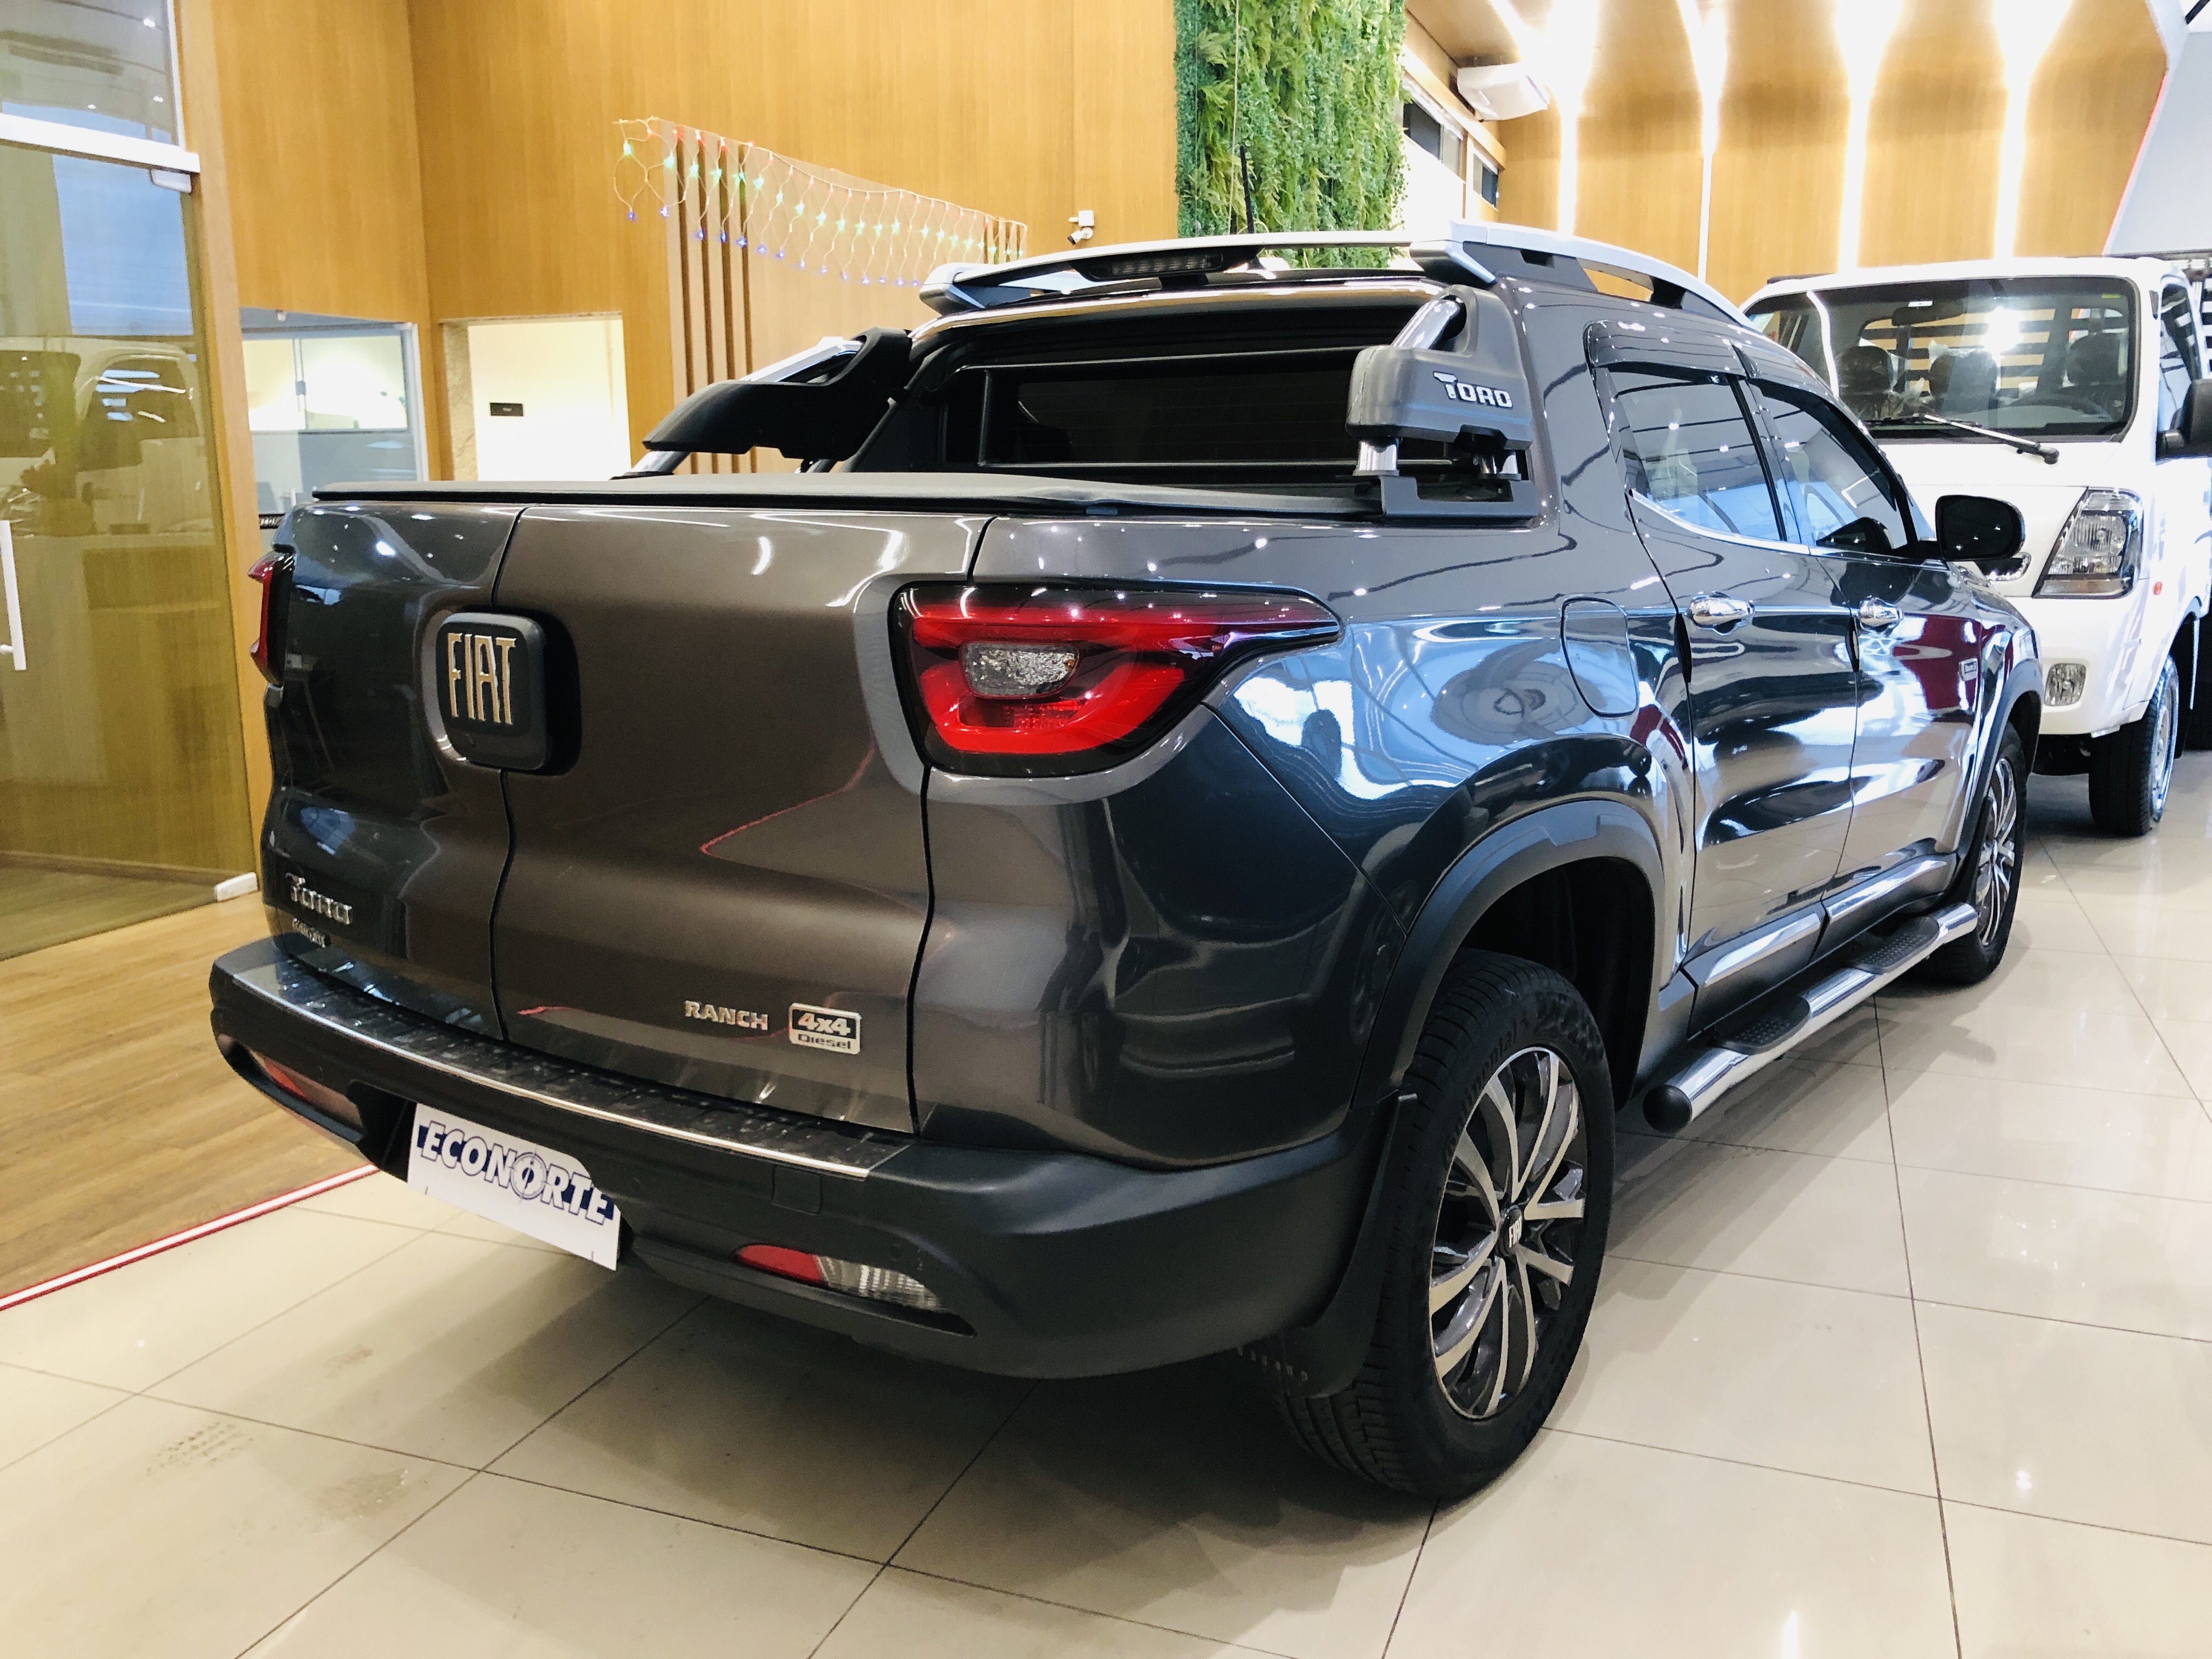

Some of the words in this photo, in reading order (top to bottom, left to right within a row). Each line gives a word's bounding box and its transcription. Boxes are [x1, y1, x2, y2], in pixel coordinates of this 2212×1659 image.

[1433, 371, 1513, 408] TORO
[447, 633, 516, 725] FIAT
[684, 1000, 768, 1030] RANCH
[798, 1013, 851, 1036] 4x4
[798, 1034, 851, 1049] Diesel
[421, 1120, 608, 1225] ECONORTE
